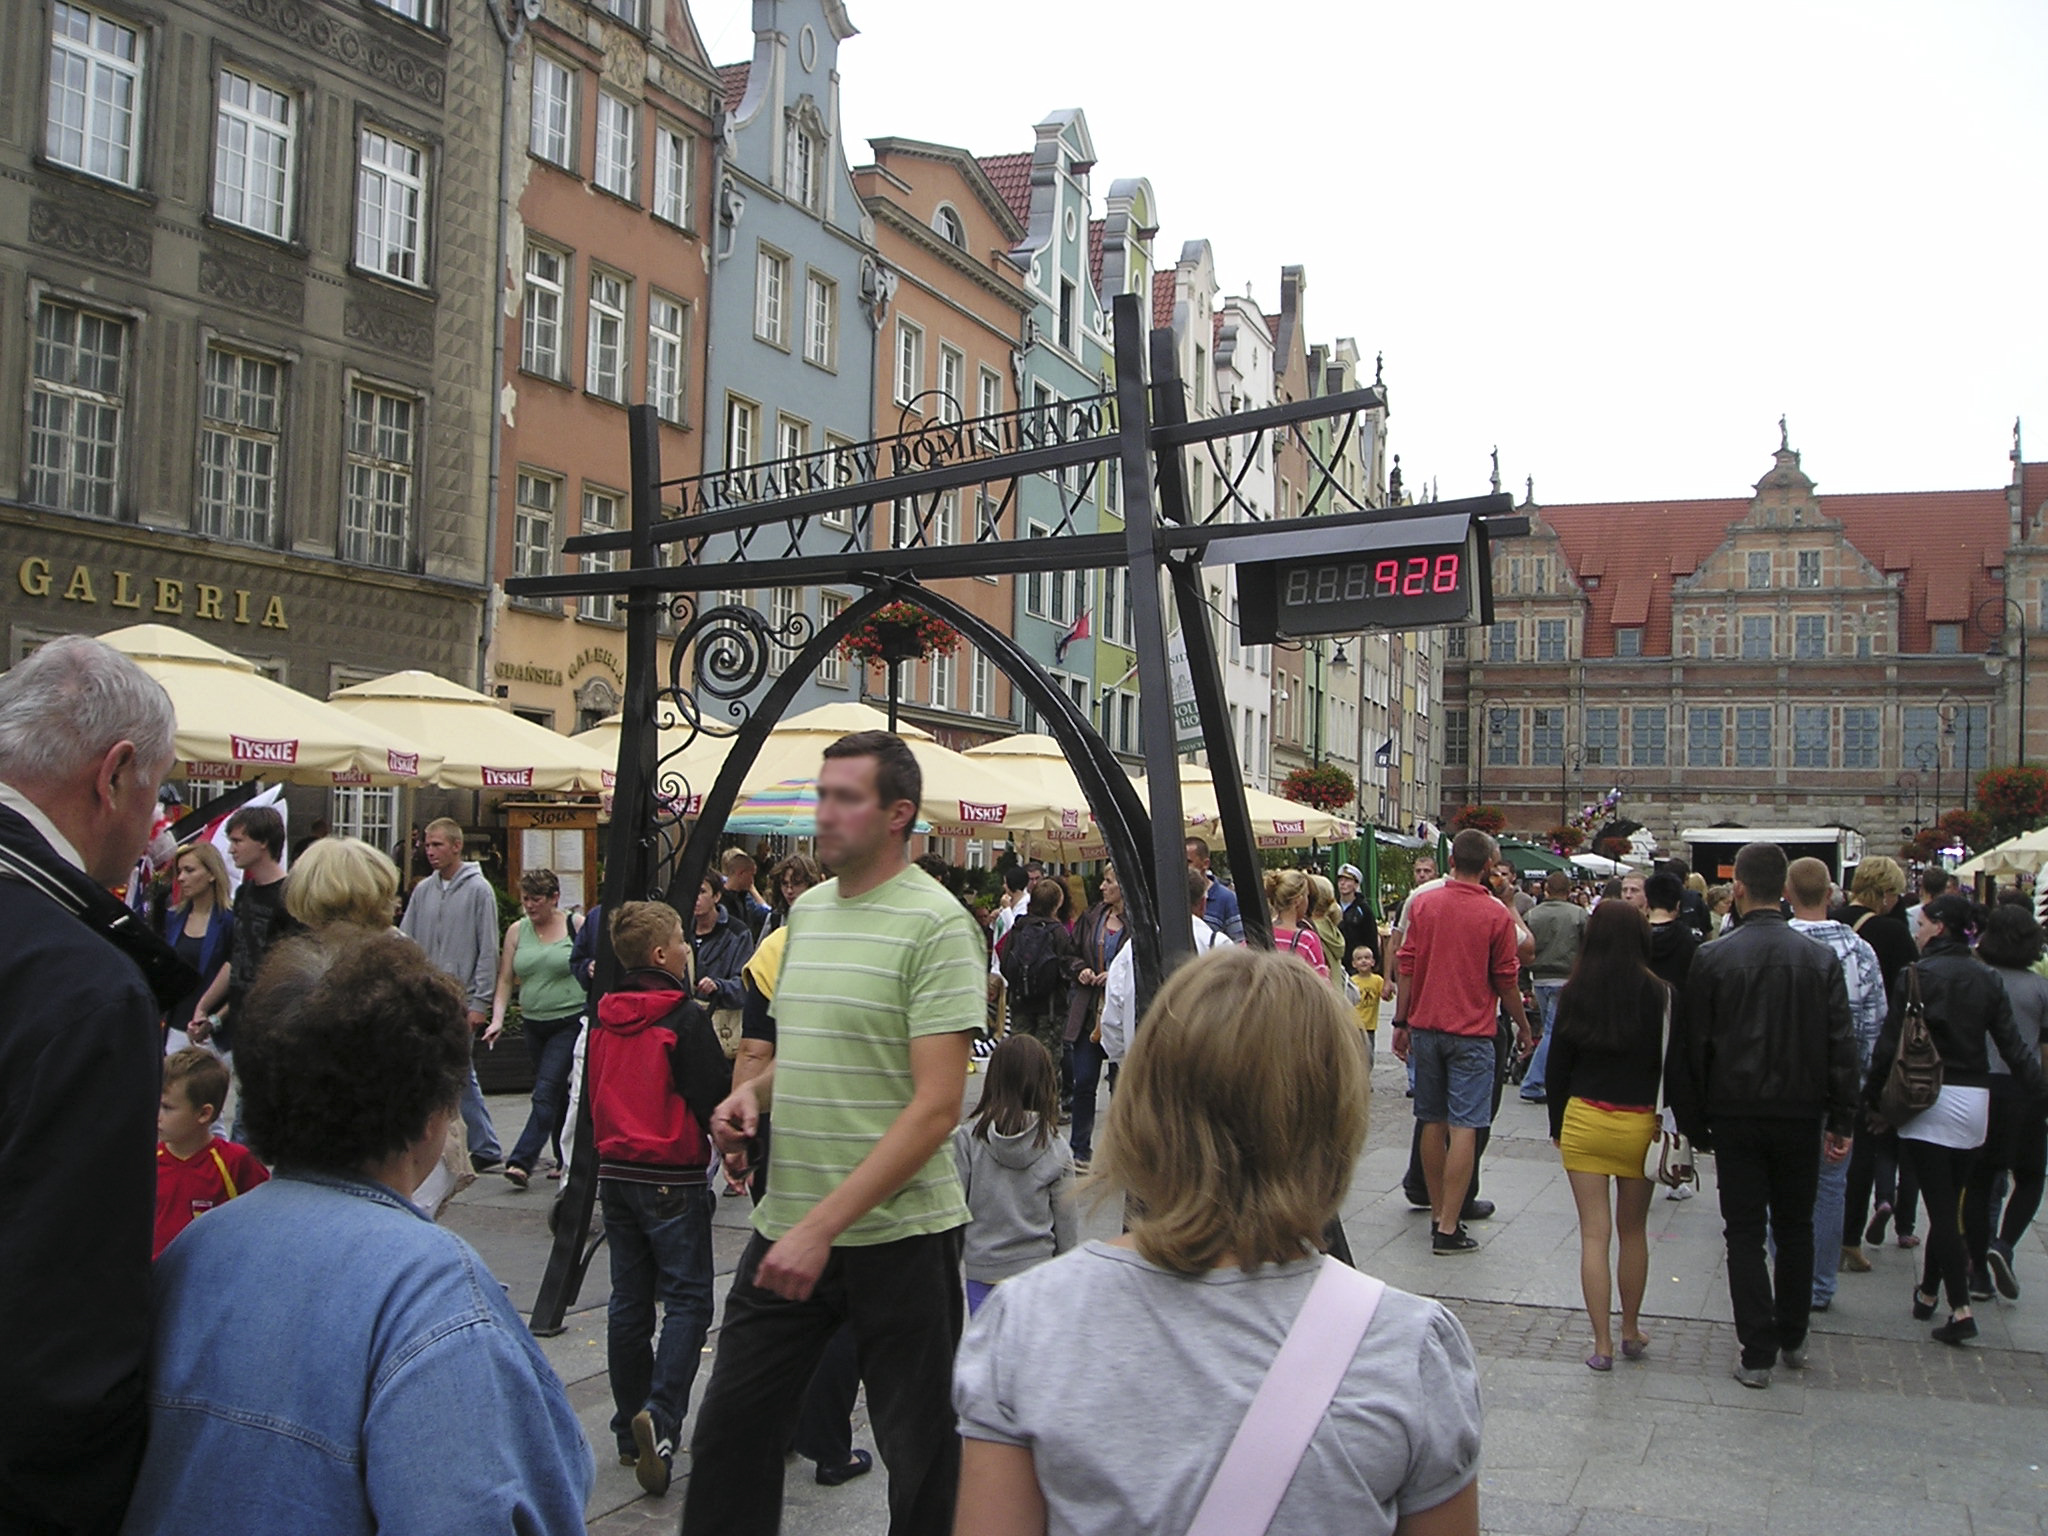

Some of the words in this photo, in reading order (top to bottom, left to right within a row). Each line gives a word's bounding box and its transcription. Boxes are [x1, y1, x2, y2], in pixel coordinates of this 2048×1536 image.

[677, 459, 828, 514] JARMARK
[891, 415, 1068, 475] DOMINIKA
[1070, 400, 1119, 441] 201
[1375, 554, 1459, 595] 928
[18, 556, 289, 630] GALERIA
[235, 737, 293, 763] TYSKIE
[390, 753, 417, 773] TYSKIE
[485, 769, 530, 786] TYSKIE
[962, 803, 1003, 821] TYSKIE
[1275, 821, 1304, 833] TYSKIE
